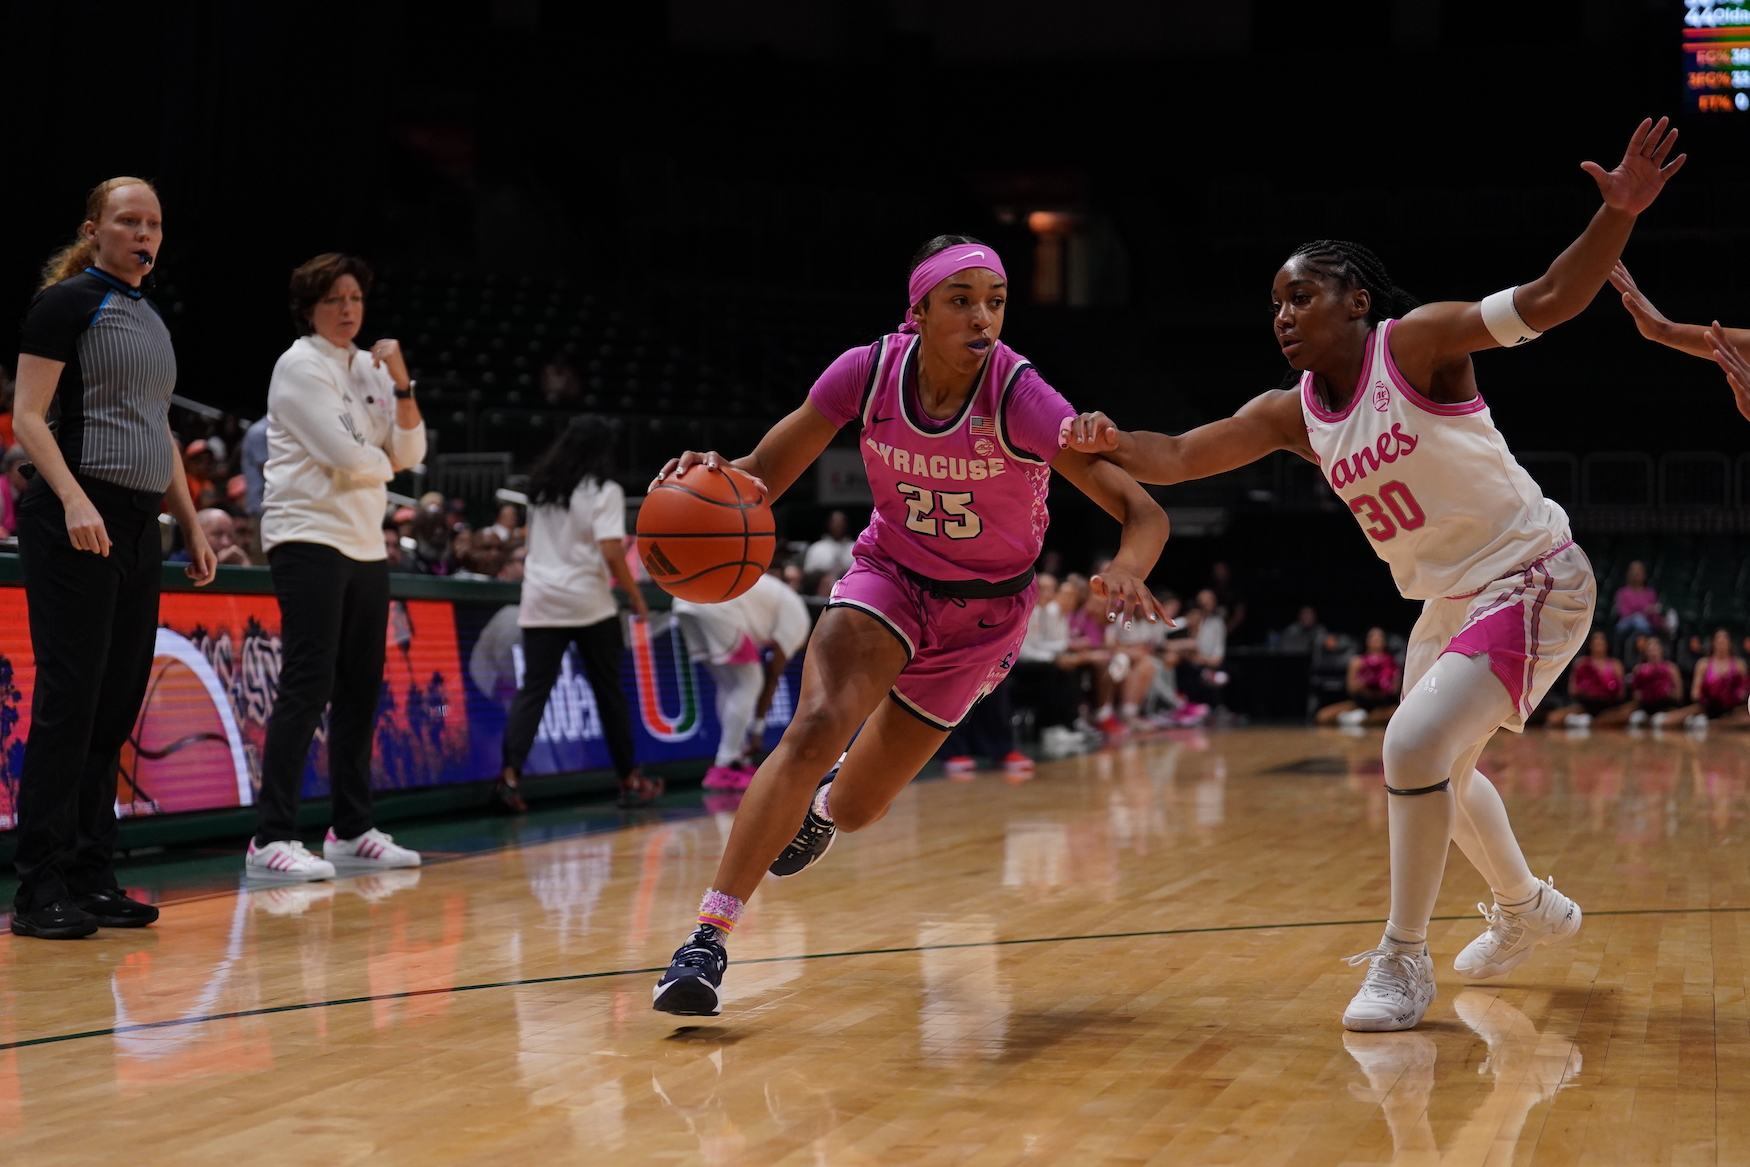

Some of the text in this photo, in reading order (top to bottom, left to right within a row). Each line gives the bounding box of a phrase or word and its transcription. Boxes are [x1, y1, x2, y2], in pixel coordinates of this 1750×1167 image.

[1713, 8, 1750, 25] Olda
[1331, 423, 1419, 490] anes
[896, 481, 983, 540] 25
[1349, 479, 1426, 542] 30
